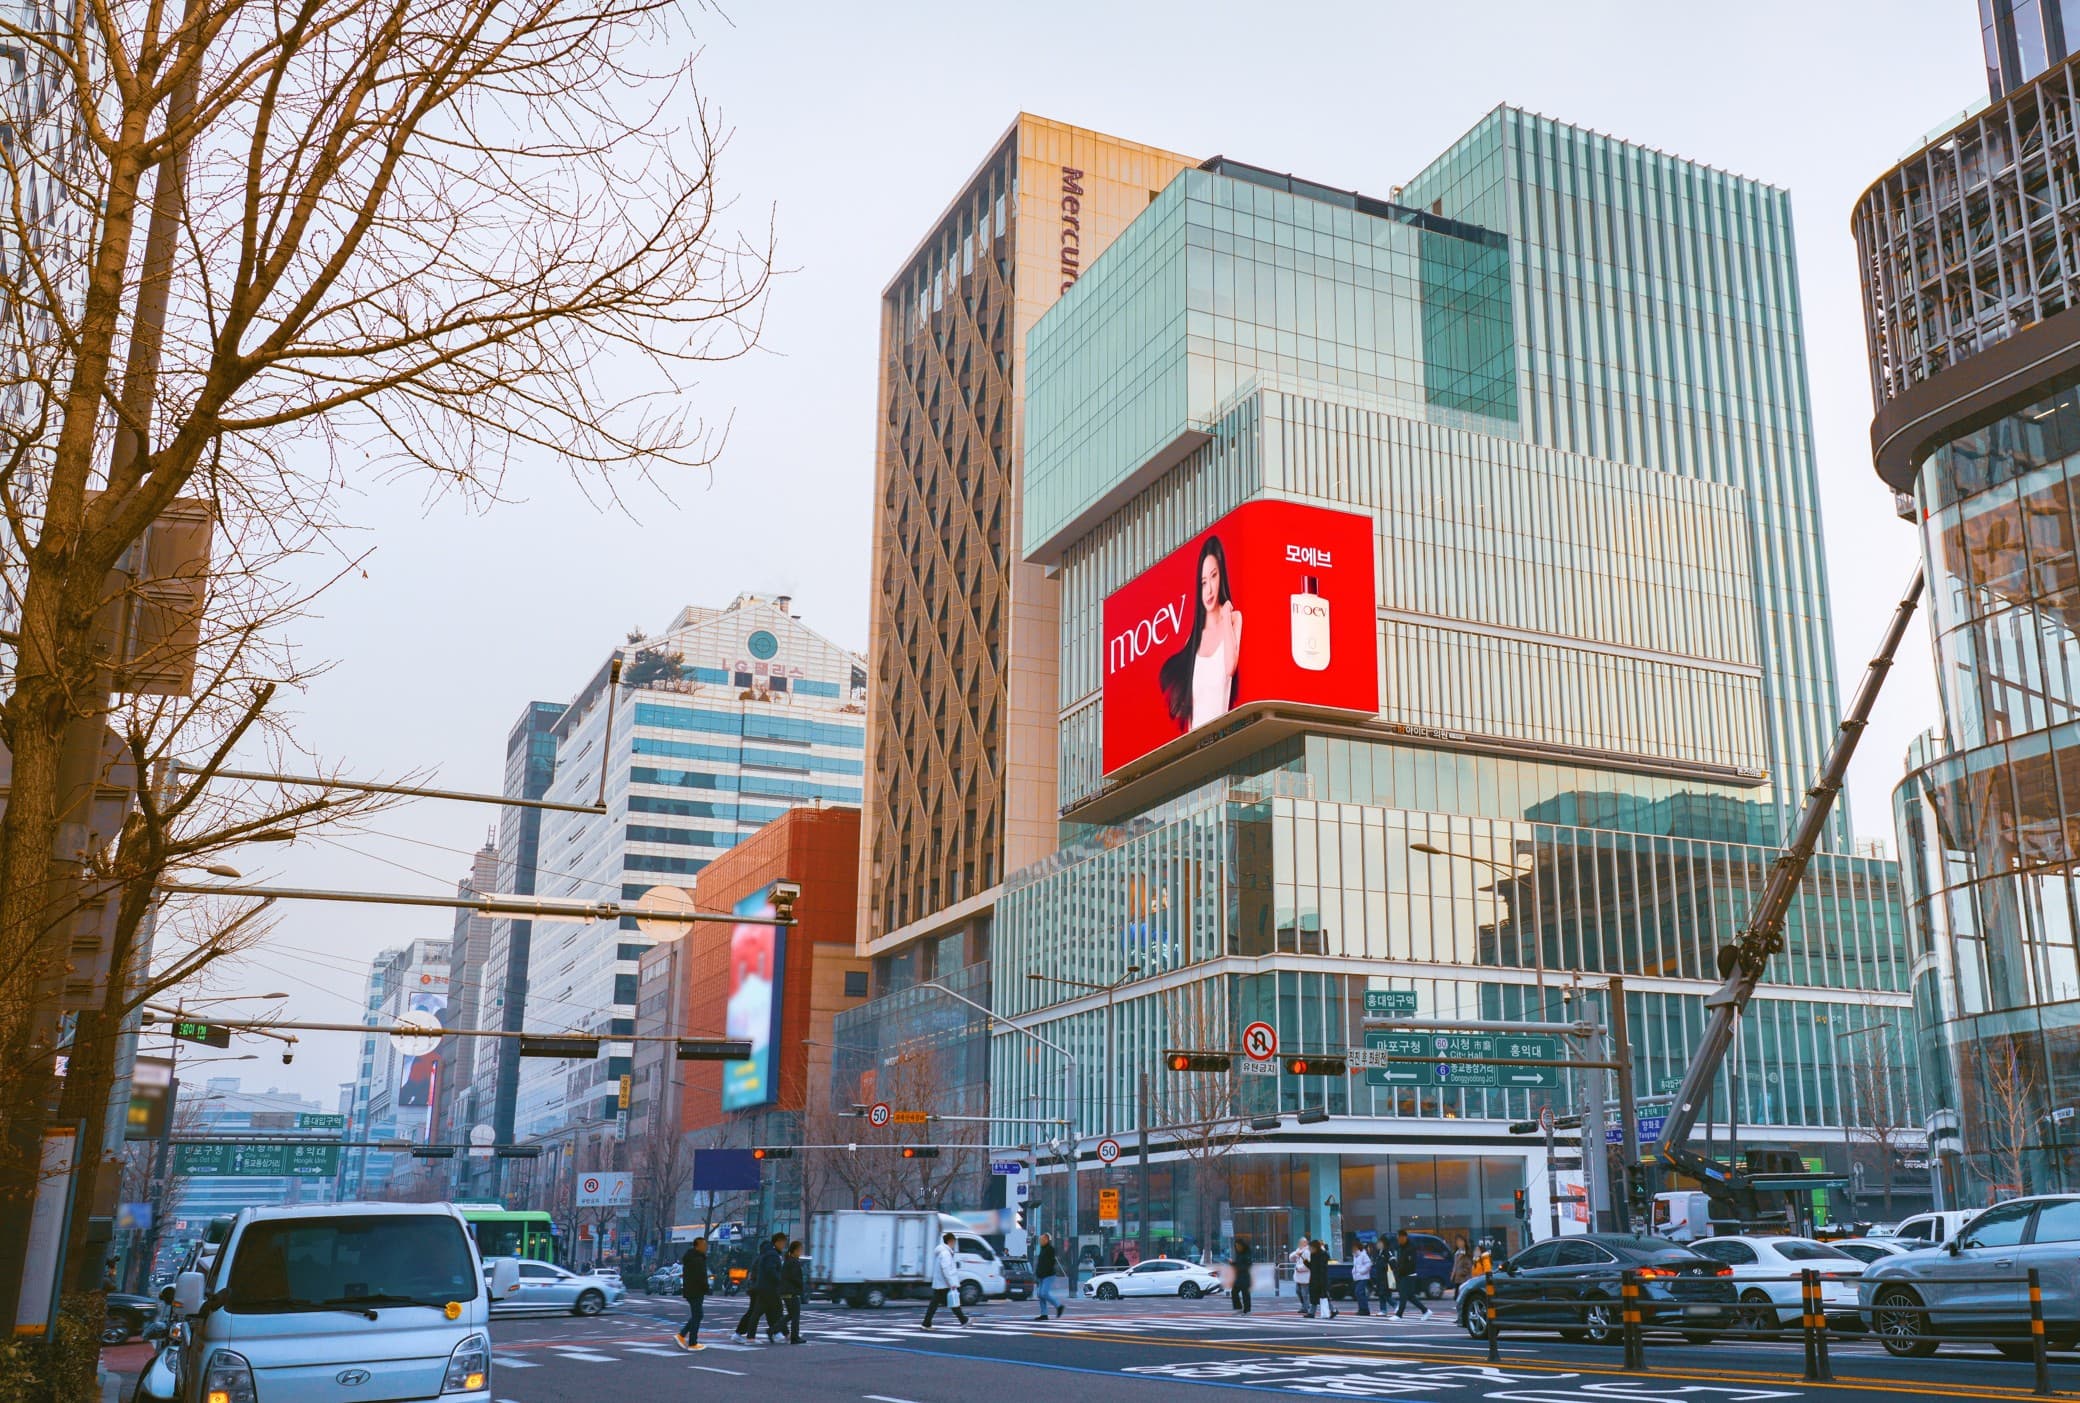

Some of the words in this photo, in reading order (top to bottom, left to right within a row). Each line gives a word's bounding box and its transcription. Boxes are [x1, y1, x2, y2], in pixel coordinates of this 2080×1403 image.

[1285, 545, 1333, 568] 모에브
[1110, 594, 1187, 675] moev
[1367, 993, 1415, 1008] 홍대입구역
[1376, 1040, 1421, 1054] 마포구청
[1437, 1039, 1446, 1048] 60
[1450, 1038, 1470, 1050] 시청
[1467, 1051, 1484, 1060] Hall
[1510, 1044, 1542, 1058] 홍익대
[1243, 1062, 1275, 1073] 유턴금지
[1440, 1066, 1446, 1074] 6
[873, 1108, 887, 1122] 50
[1101, 1145, 1117, 1157] 50
